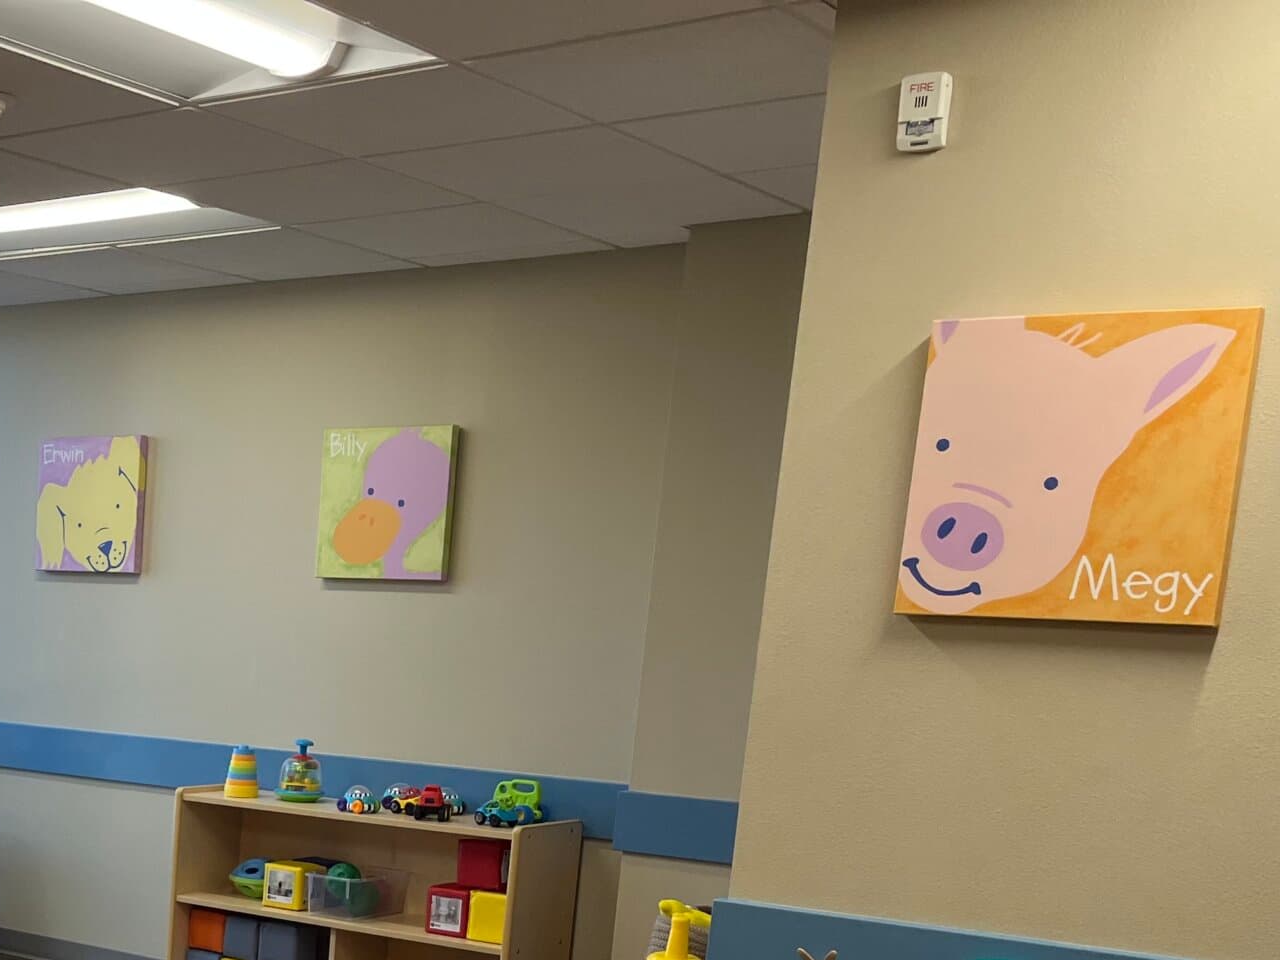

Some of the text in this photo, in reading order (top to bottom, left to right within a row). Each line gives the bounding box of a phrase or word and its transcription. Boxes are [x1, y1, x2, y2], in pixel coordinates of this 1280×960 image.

[910, 81, 935, 93] FIRE
[43, 443, 84, 464] Erwin
[329, 431, 367, 463] Billy
[1068, 553, 1214, 616] Megy
